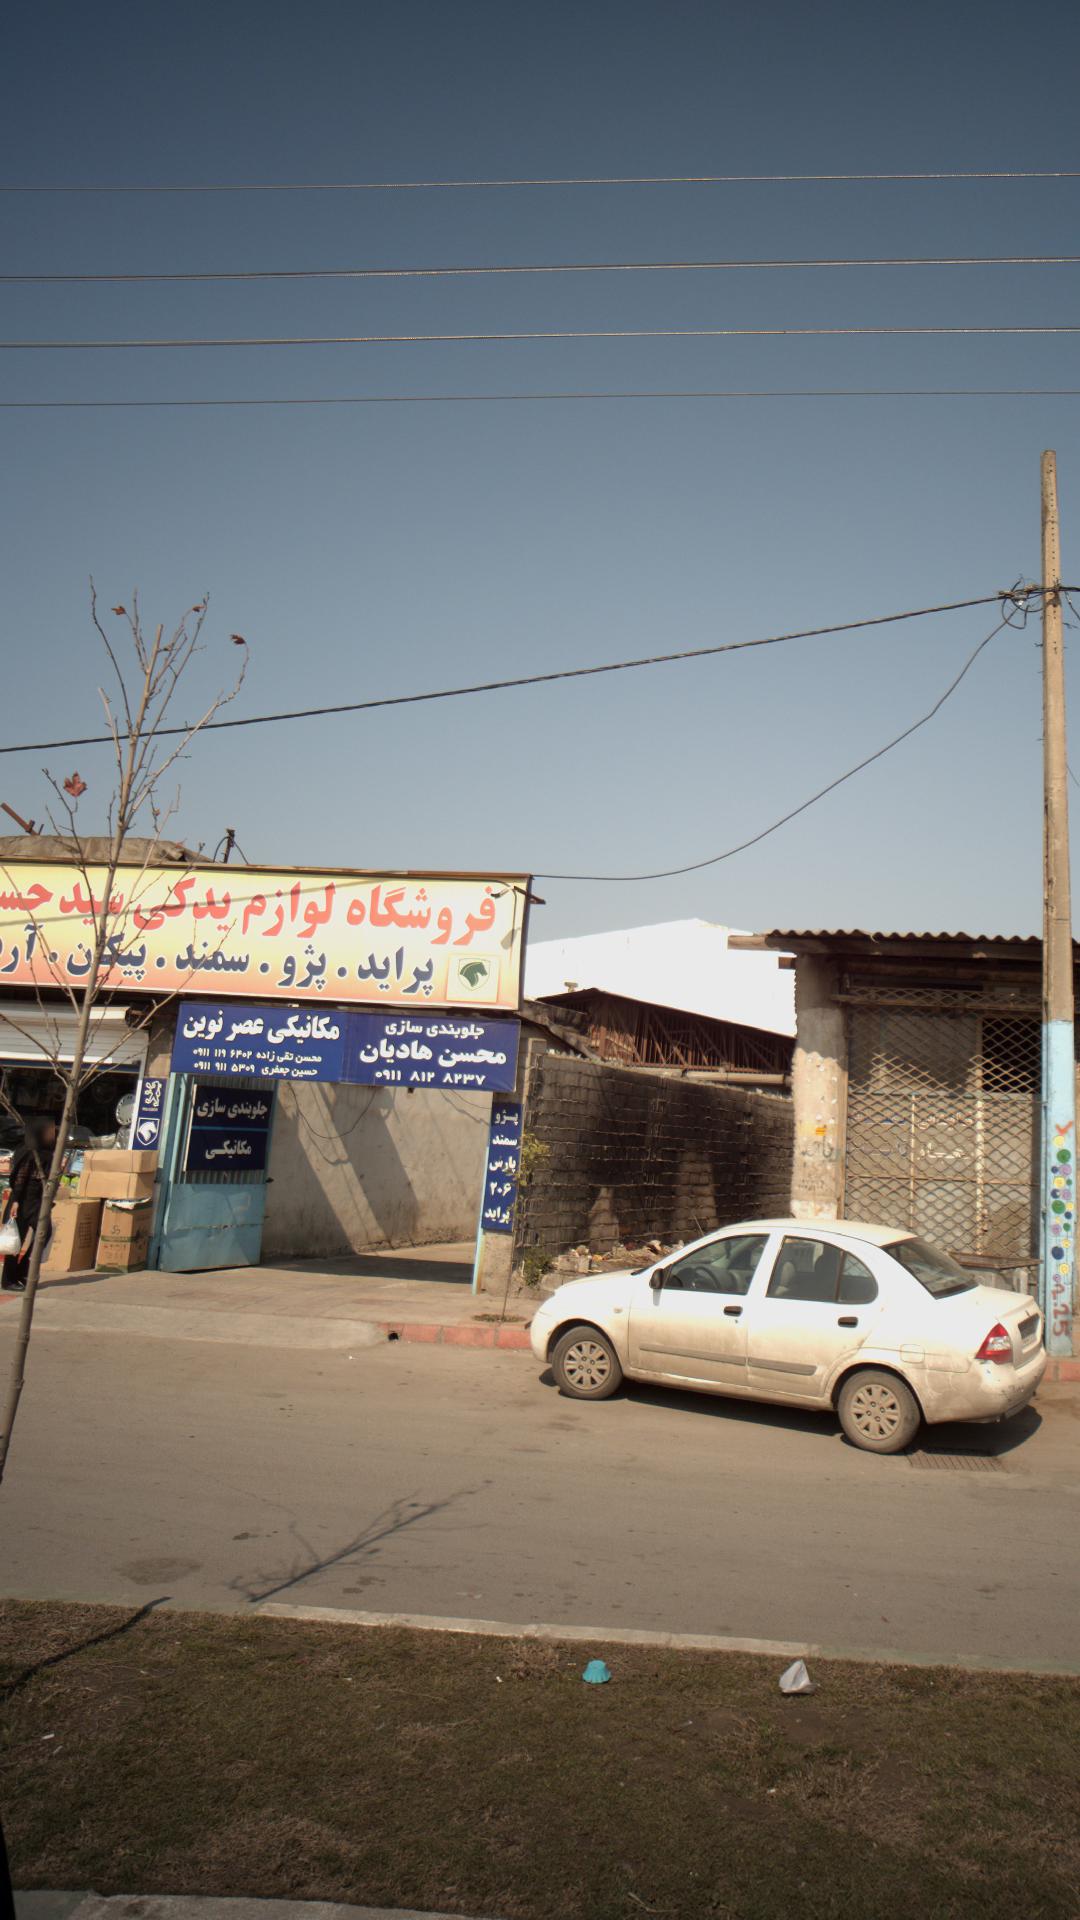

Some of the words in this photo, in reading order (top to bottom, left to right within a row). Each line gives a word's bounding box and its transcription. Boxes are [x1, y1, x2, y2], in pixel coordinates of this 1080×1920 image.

[59, 882, 125, 924] سید
[133, 877, 231, 931] یدکی
[242, 881, 336, 939] لوازم
[346, 885, 496, 946] فروشگاه
[0, 923, 44, 973] آر
[66, 932, 147, 981] پیکن
[176, 941, 249, 973] سمند
[278, 944, 327, 990] پژو
[357, 947, 434, 996] پراید
[182, 1010, 224, 1040] نوین
[225, 1017, 264, 1041] عصر
[267, 1014, 340, 1044] مکانیکی
[385, 1020, 423, 1036] سازی
[426, 1023, 485, 1040] جلوبندی
[192, 1047, 210, 1057] ۰۹۱۱
[256, 1049, 275, 1062] زاده
[276, 1051, 294, 1063] تقی
[295, 1052, 322, 1064] محسن
[359, 1038, 433, 1064] هادیان
[437, 1047, 507, 1068] محسن
[193, 1061, 211, 1071] ۰۹۱۱
[261, 1064, 290, 1077] جعفری
[291, 1066, 318, 1078] حسین
[375, 1069, 402, 1081] ۰۹۱۱
[409, 1070, 435, 1083] ۸۱۲
[442, 1072, 486, 1086] ۸۲۳۷
[196, 1098, 226, 1118] سازی
[227, 1100, 268, 1119] جلوبندی
[495, 1109, 518, 1126] پژو
[205, 1139, 252, 1160] مکانیکی
[492, 1134, 517, 1146] سمند
[489, 1156, 517, 1173] پارس
[490, 1181, 512, 1197] ۲۰۶
[484, 1206, 510, 1224] پراید
